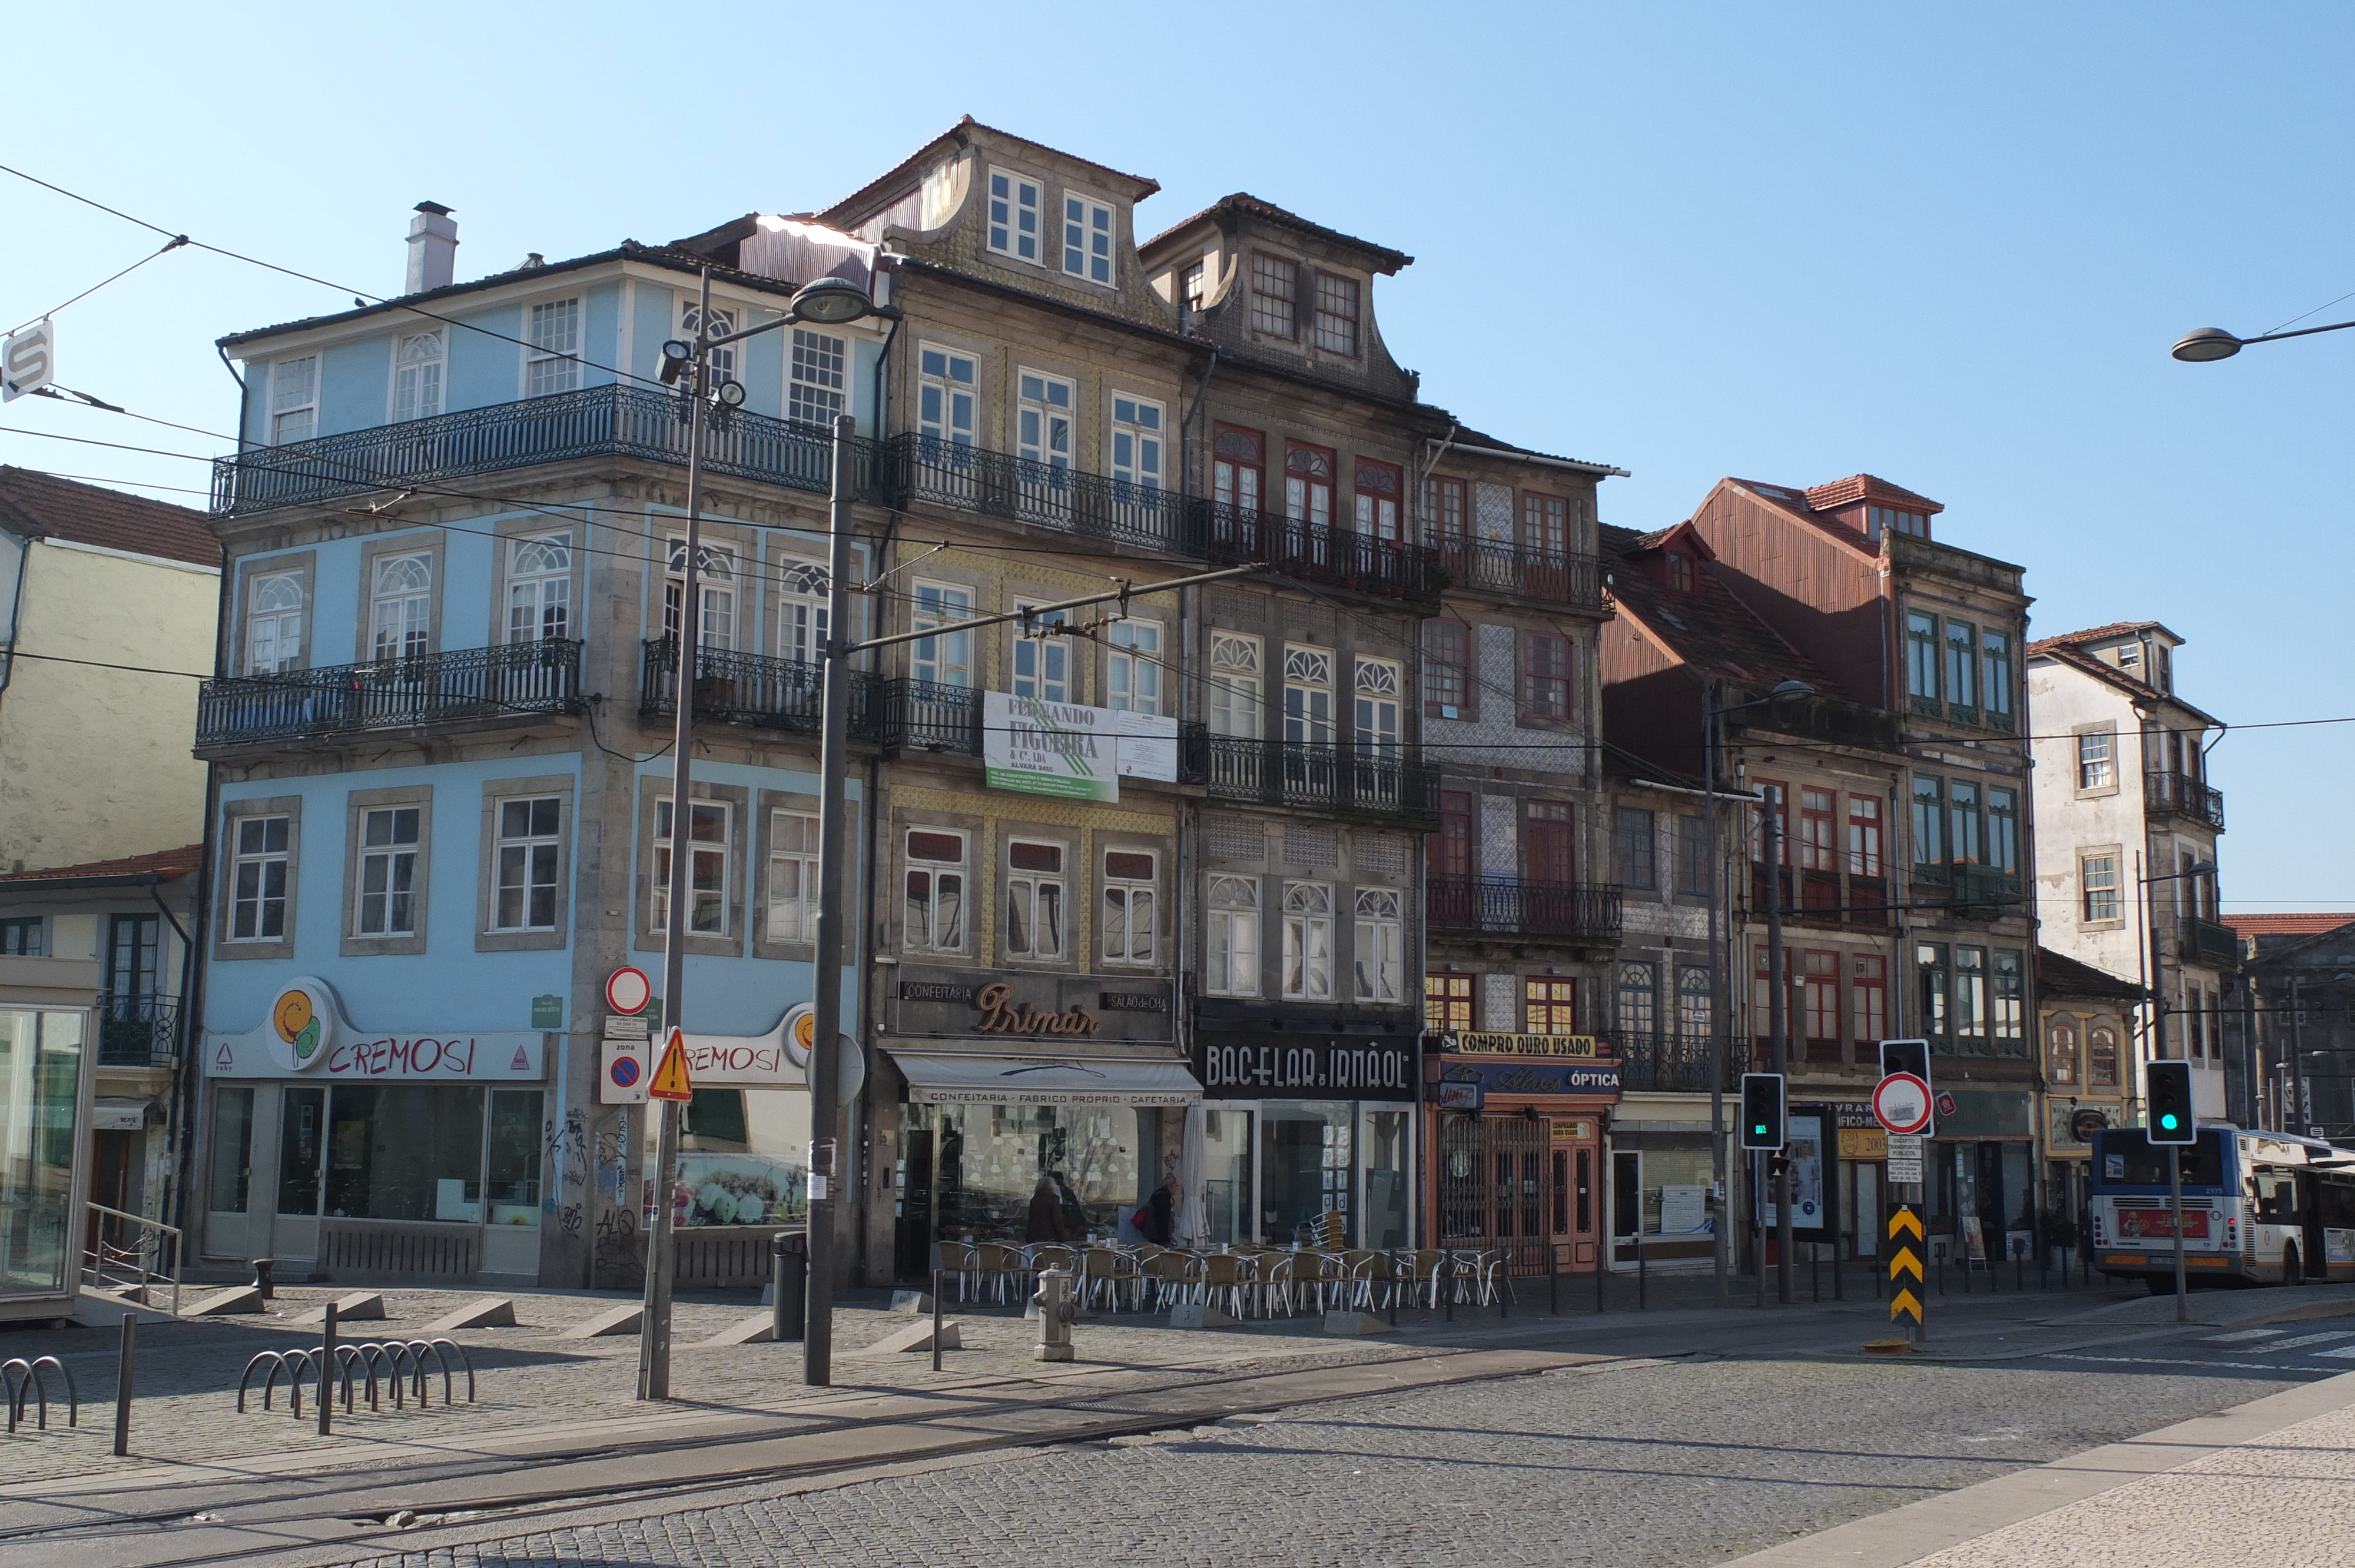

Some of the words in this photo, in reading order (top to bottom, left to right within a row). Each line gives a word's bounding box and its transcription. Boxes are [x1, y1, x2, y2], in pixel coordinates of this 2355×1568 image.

[1008, 698, 1095, 726] FERNANDO
[1009, 720, 1099, 759] FIGUEIRA
[1010, 749, 1016, 760] &
[1033, 753, 1046, 764] LDA
[908, 985, 971, 999] CONFEITARIA
[329, 1037, 475, 1075] CREMOSI
[1462, 1034, 1513, 1053] COMPRO
[1517, 1035, 1549, 1055] OURO
[1553, 1037, 1590, 1055] USADO
[684, 1045, 780, 1073] REMOSI
[1206, 1045, 1315, 1087] BACELAR
[1571, 1069, 1620, 1087] ÓPTICA
[930, 1092, 1007, 1102] CONFEITARIA
[1019, 1094, 1067, 1103] FABRICO
[1072, 1093, 1120, 1104] PRÓPRIO
